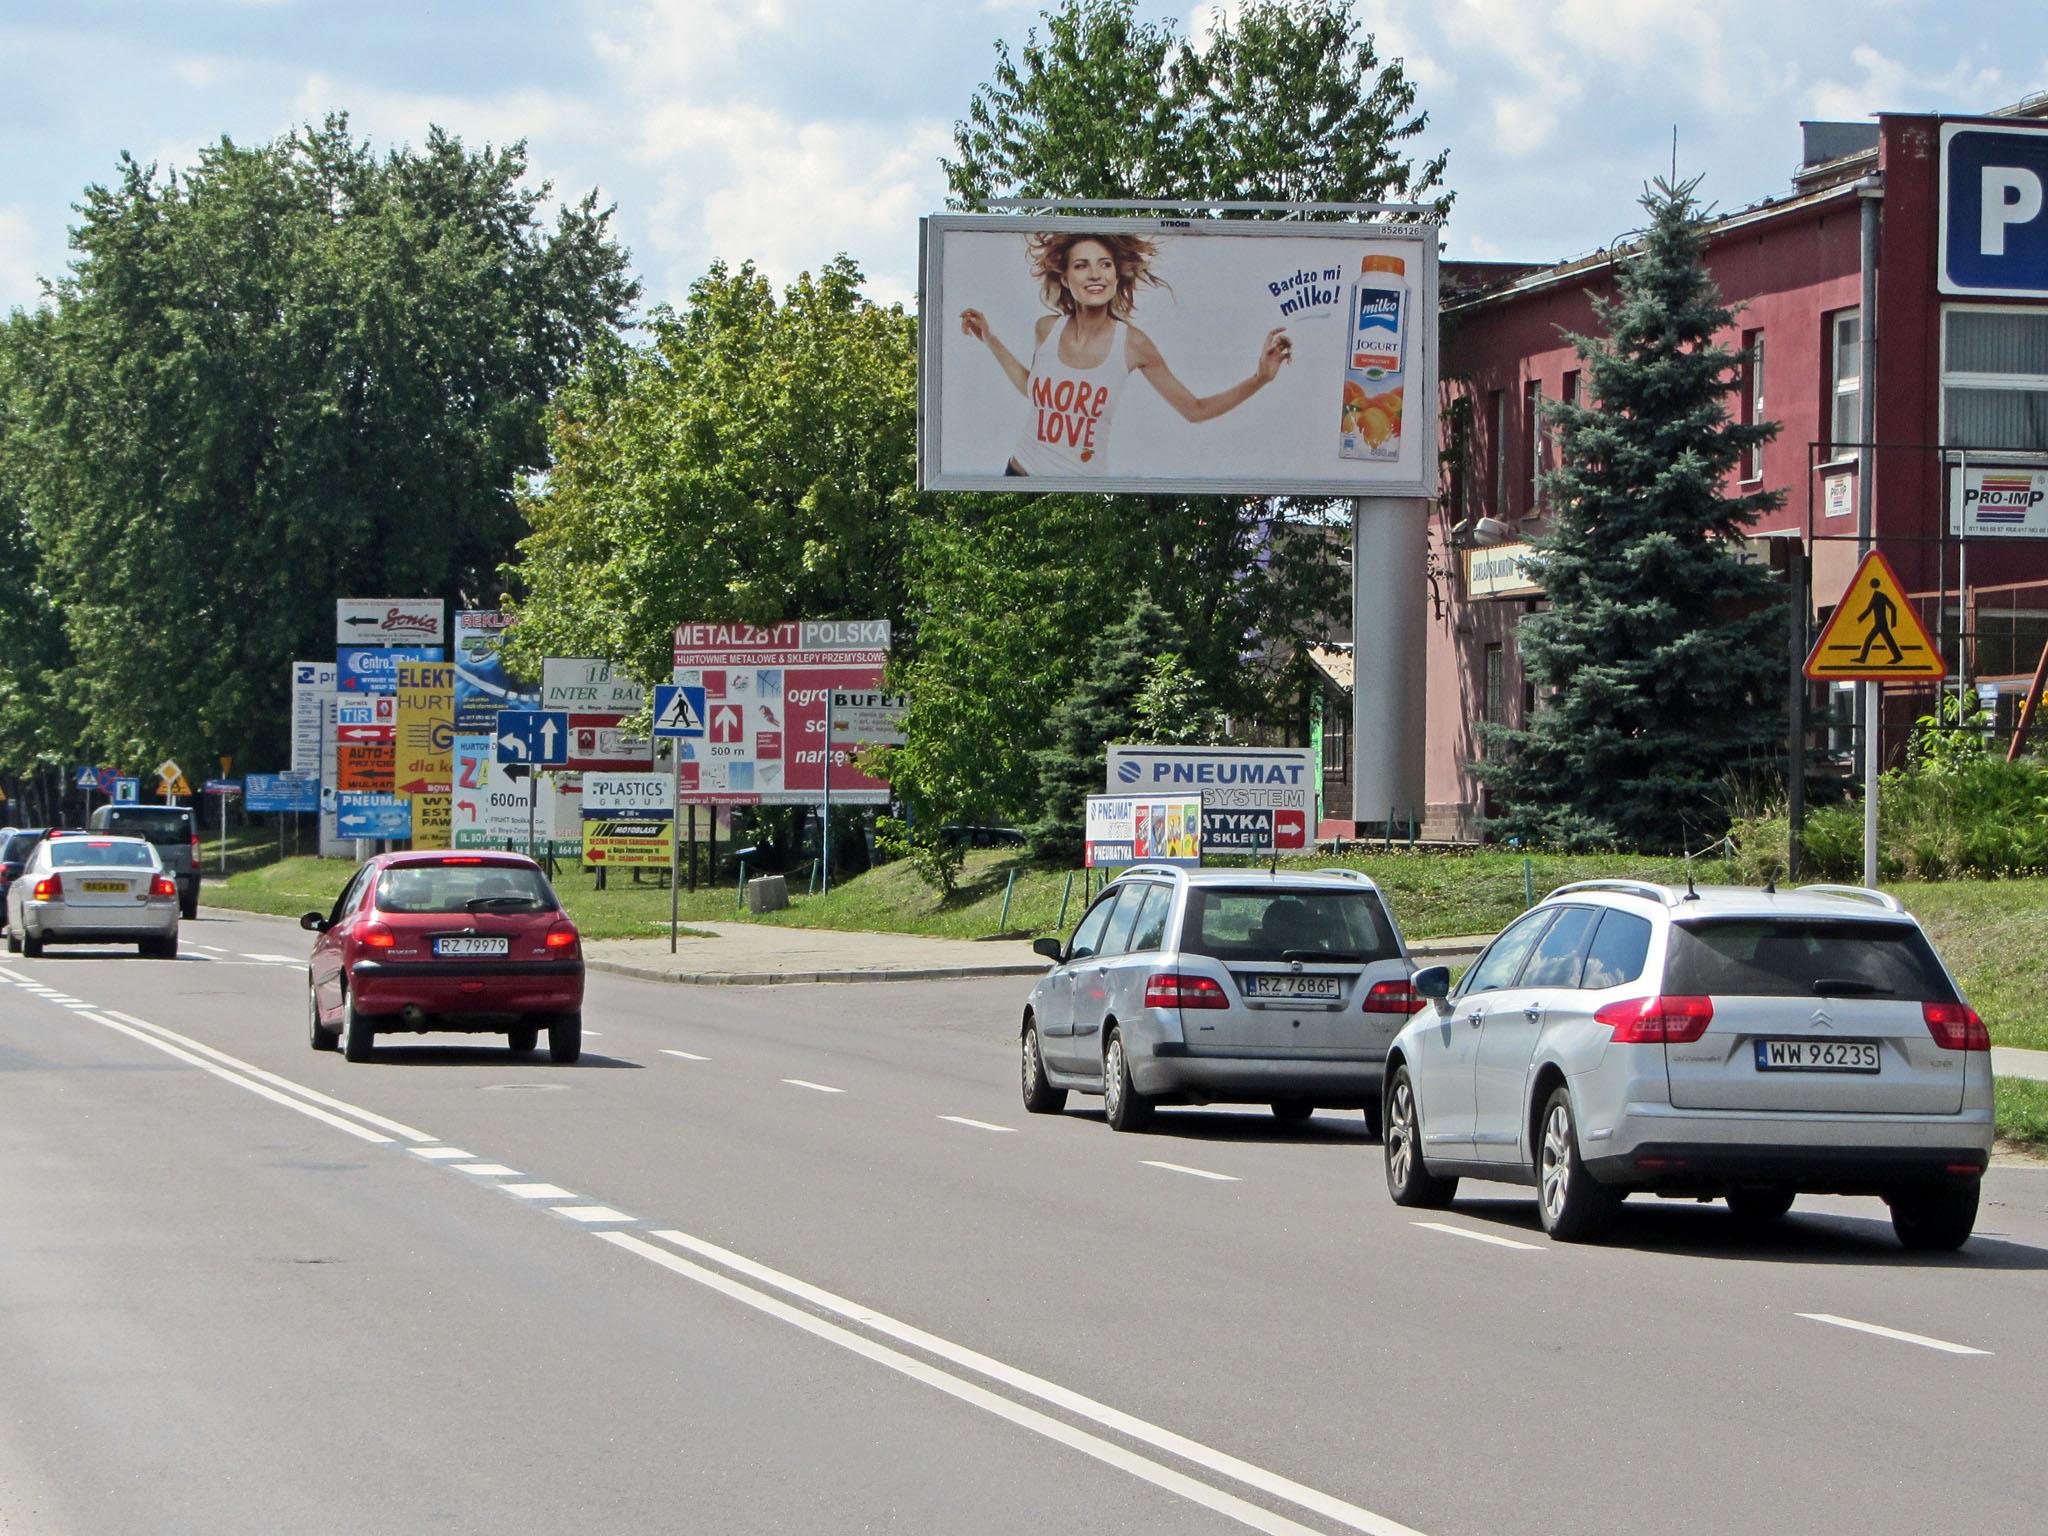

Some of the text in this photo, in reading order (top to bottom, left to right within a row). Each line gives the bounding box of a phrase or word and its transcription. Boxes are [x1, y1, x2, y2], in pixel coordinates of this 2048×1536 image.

[1980, 166, 2042, 255] P
[1268, 264, 1341, 297] Bardzo mi
[1280, 285, 1340, 316] milko!
[1362, 297, 1397, 314] milko
[1356, 339, 1398, 352] JOGURT
[1036, 408, 1097, 448] LOVE
[1964, 489, 2044, 507] PRO-IMP
[806, 622, 888, 643] POLSKA
[676, 655, 727, 664] HURTOWNIE
[729, 654, 777, 663] METALOWE
[778, 653, 785, 663] &
[787, 653, 821, 663] SKLEPY
[550, 687, 598, 700] INTER
[343, 709, 369, 722] TIR
[711, 747, 745, 756] 500 m
[409, 760, 434, 772] dla
[1153, 763, 1304, 784] PNEUMAT
[598, 782, 663, 796] PLASTICS
[1202, 788, 1305, 807] SYSTEM
[1098, 802, 1132, 820] PNEUMAT
[441, 940, 506, 952] RZ 79979
[1258, 977, 1335, 993] RZ 7686F
[1770, 1043, 1875, 1066] WW 9623S
